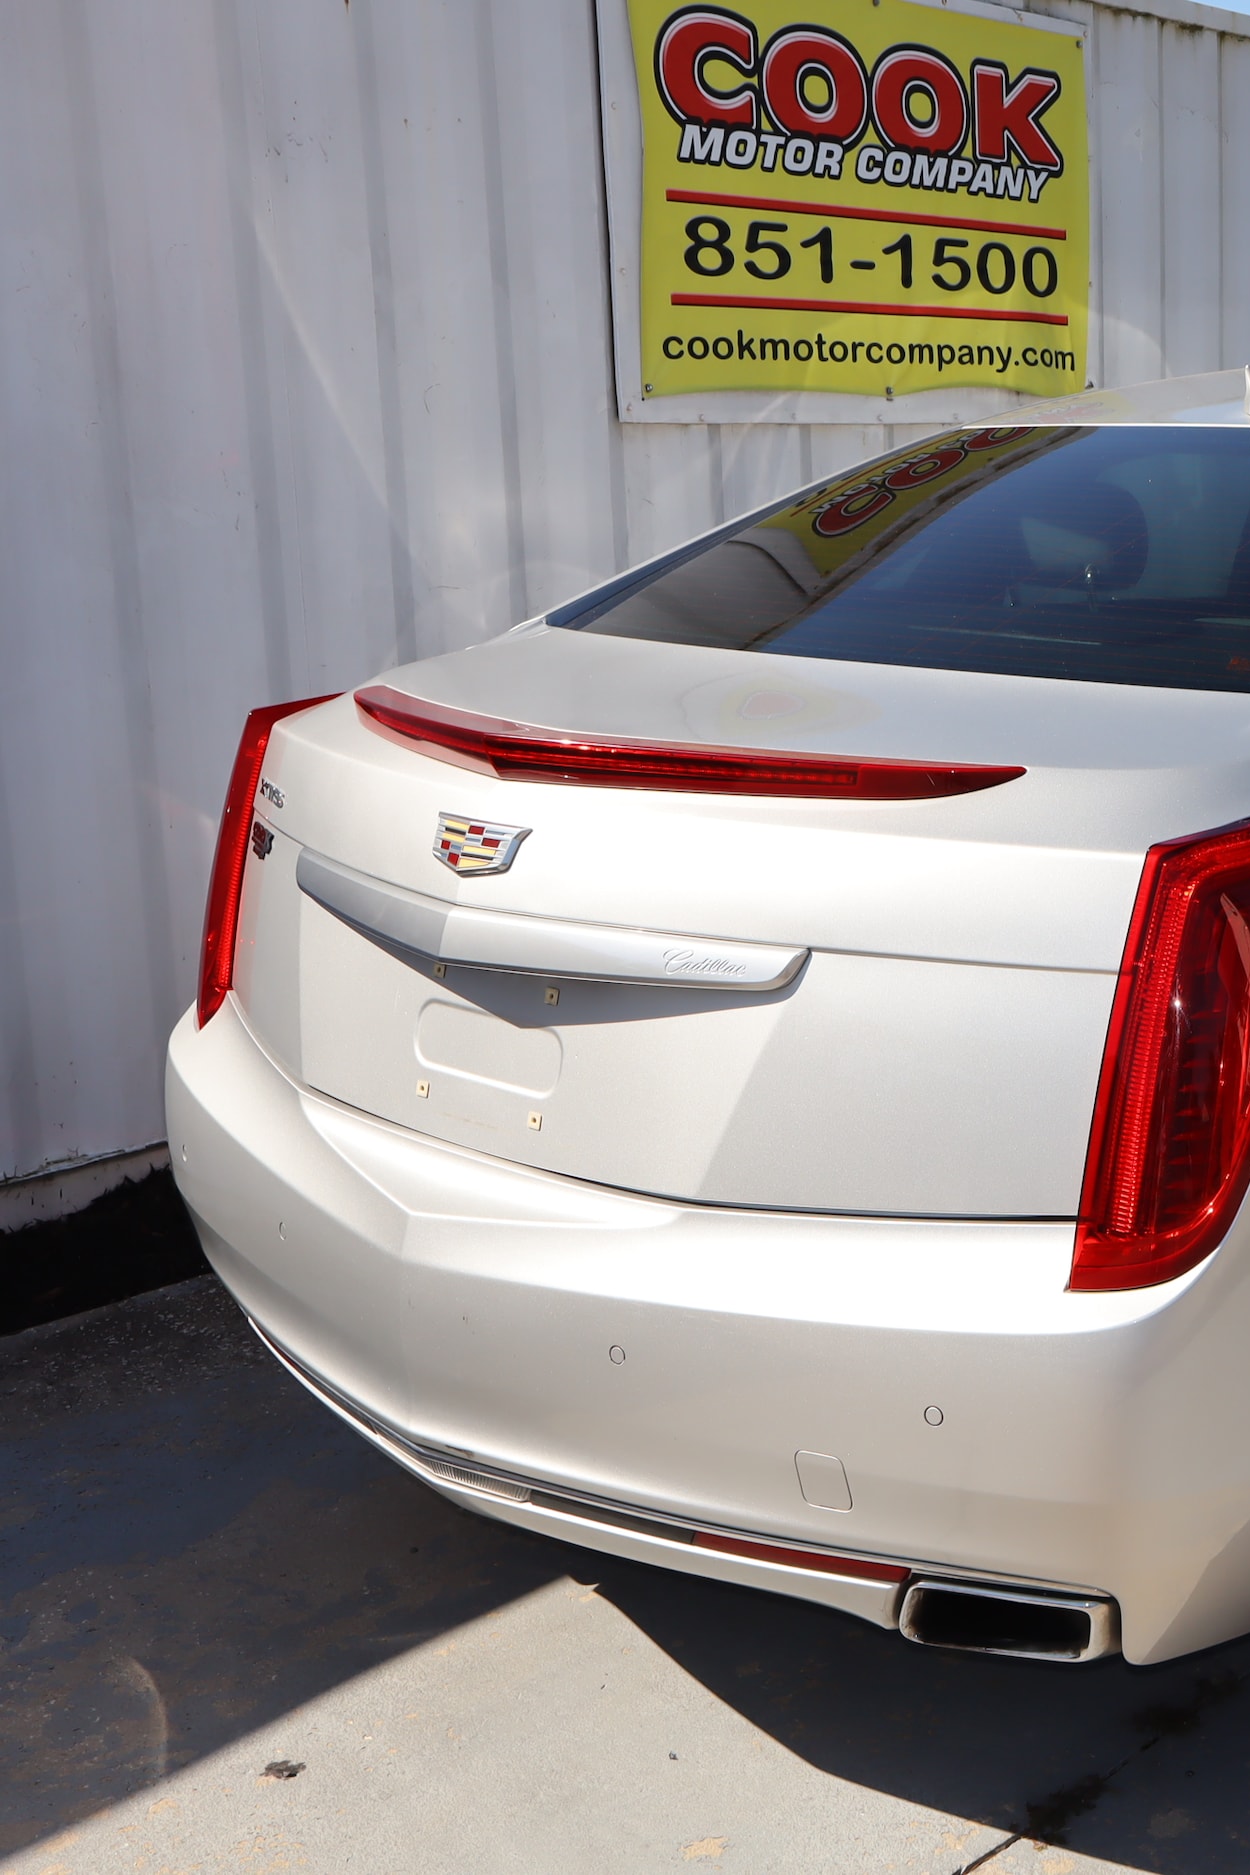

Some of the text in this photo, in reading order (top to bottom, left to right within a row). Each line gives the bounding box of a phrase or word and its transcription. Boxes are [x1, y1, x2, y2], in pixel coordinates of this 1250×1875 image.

[654, 5, 1063, 173] COOK
[678, 123, 1050, 202] MOTOR COMPANY
[683, 215, 1059, 298] 851-1500
[661, 329, 1076, 373] cookmotorcompany.com
[662, 949, 747, 977] Cadillac
